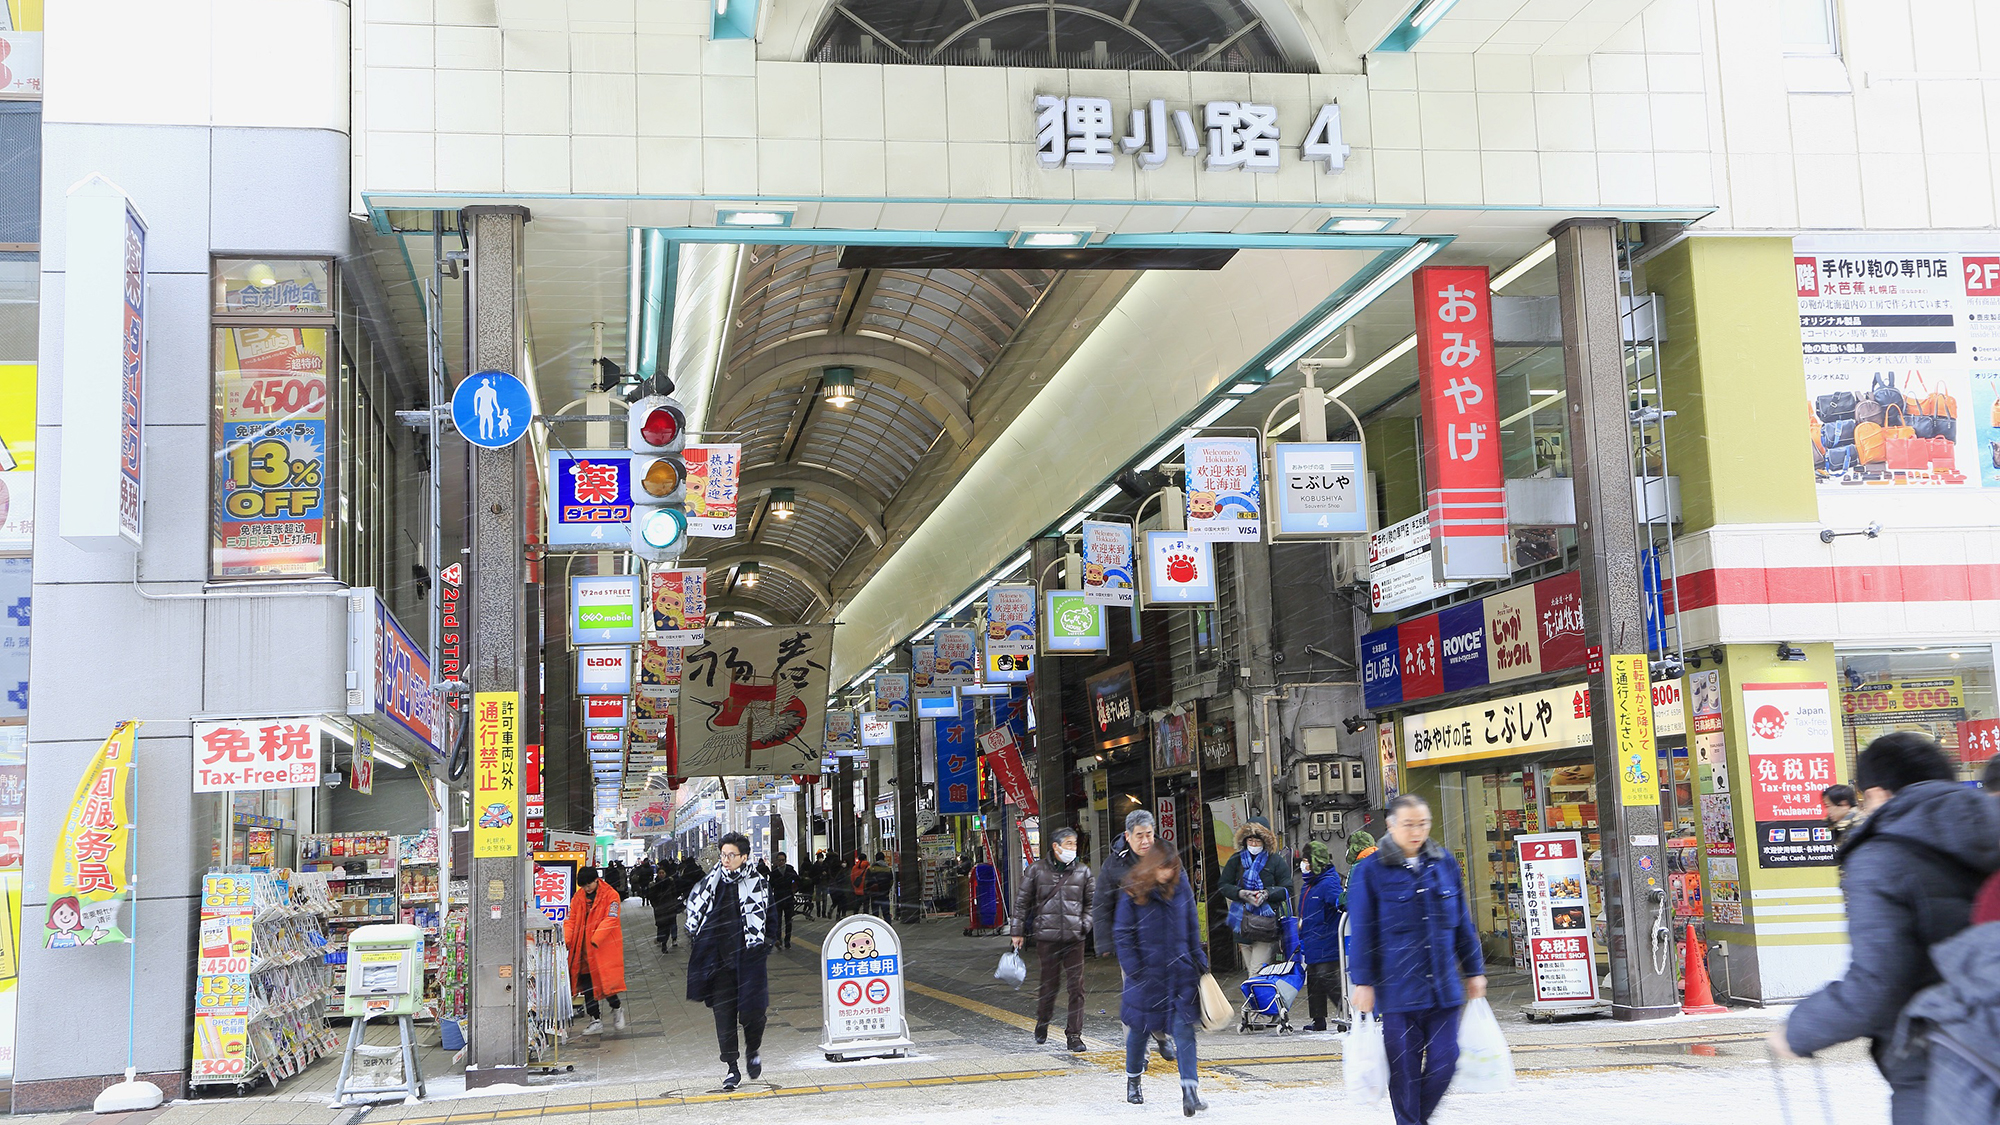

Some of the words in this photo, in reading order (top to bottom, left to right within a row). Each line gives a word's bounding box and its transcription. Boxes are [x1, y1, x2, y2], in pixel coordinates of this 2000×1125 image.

[1035, 94, 1281, 172] 狸小路
[1300, 97, 1350, 175] 4
[1822, 258, 1948, 278] 手作り鞄の専門店
[1966, 263, 2000, 290] 2F
[1824, 281, 1866, 295] 水芭蕉
[1869, 285, 1898, 295] 札幌店
[291, 357, 323, 371] 超特价
[1437, 284, 1487, 462] おみやげ
[242, 379, 326, 415] 4500
[1202, 448, 1232, 456] Welcome
[227, 440, 322, 488] 13%
[1205, 456, 1239, 464] Hokkaido
[721, 453, 734, 500] ようこそ
[1196, 464, 1247, 477] 欢迎来到
[577, 463, 619, 503] 薬
[1204, 477, 1241, 491] 北海道
[1291, 475, 1350, 490] こぶしや
[120, 477, 138, 522] 免税
[226, 489, 321, 518] OFF
[566, 507, 629, 520] ダイコク
[1317, 514, 1329, 528] 4
[240, 523, 305, 536] 免税结账超过
[591, 526, 604, 539] 4
[712, 523, 733, 531] VISA
[1238, 526, 1258, 534] VISA
[1090, 543, 1125, 555] 欢迎来到
[1095, 554, 1122, 565] 北海道
[604, 588, 631, 596] STREET
[1118, 593, 1132, 601] VISA
[1179, 588, 1187, 598] 4
[444, 588, 460, 627] 2nd
[995, 603, 1028, 613] 欢迎来到
[581, 612, 603, 622] GEO
[604, 612, 632, 622] mobile
[999, 612, 1024, 621] 北海道
[1492, 607, 1522, 645] じゃが
[602, 629, 611, 639] 4
[691, 633, 704, 641] VISA
[1073, 637, 1081, 646] 4
[1442, 627, 1483, 657] ROYCE'
[1405, 634, 1436, 676] 六花亭
[443, 633, 460, 711] STRT
[1007, 671, 1014, 680] 4
[1365, 654, 1399, 683] 白い恋人
[601, 683, 608, 691] 4
[1616, 659, 1634, 752] ご通行ください
[1632, 658, 1650, 751] 自転車から降りて
[1902, 687, 1959, 710] 800円
[1414, 721, 1473, 754] おみやげの店
[1484, 698, 1553, 745] こぶしや
[1794, 717, 1828, 726] Tax-free
[1807, 726, 1829, 737] Shop
[201, 724, 314, 765] 免税
[479, 701, 499, 792] 通行禁止
[501, 701, 514, 791] 許可車両以外
[199, 767, 288, 786] Tax-Free
[290, 763, 315, 774] 8%
[1757, 757, 1829, 782] 免税店
[292, 774, 315, 782] OFF
[1760, 782, 1803, 792] Tax-free
[1804, 781, 1830, 791] Shop
[1782, 793, 1811, 803] 면세점
[73, 741, 118, 895] 中国服务员
[1160, 800, 1175, 842] 小樽の
[1534, 843, 1563, 858] 2階
[1769, 854, 1789, 862] Credit
[1807, 853, 1834, 861] Accepted
[207, 877, 251, 895] 13%
[535, 869, 567, 903] 薬
[1536, 871, 1547, 898] 水芭蕉
[206, 895, 251, 906] OFF
[1524, 862, 1541, 937] 手作り鞄の専門店
[543, 907, 566, 922] コク
[1539, 939, 1580, 953] 免税店
[1551, 952, 1567, 960] FREE
[1568, 952, 1586, 960] SHOP
[207, 958, 248, 975] 4500
[831, 958, 894, 977] 歩行者専用
[202, 975, 247, 995] 13%
[200, 995, 246, 1007] OFF
[839, 1006, 891, 1018] 防犯カメラ作動中
[201, 1059, 245, 1075] 300
[363, 1057, 394, 1067] 空袋入れ
